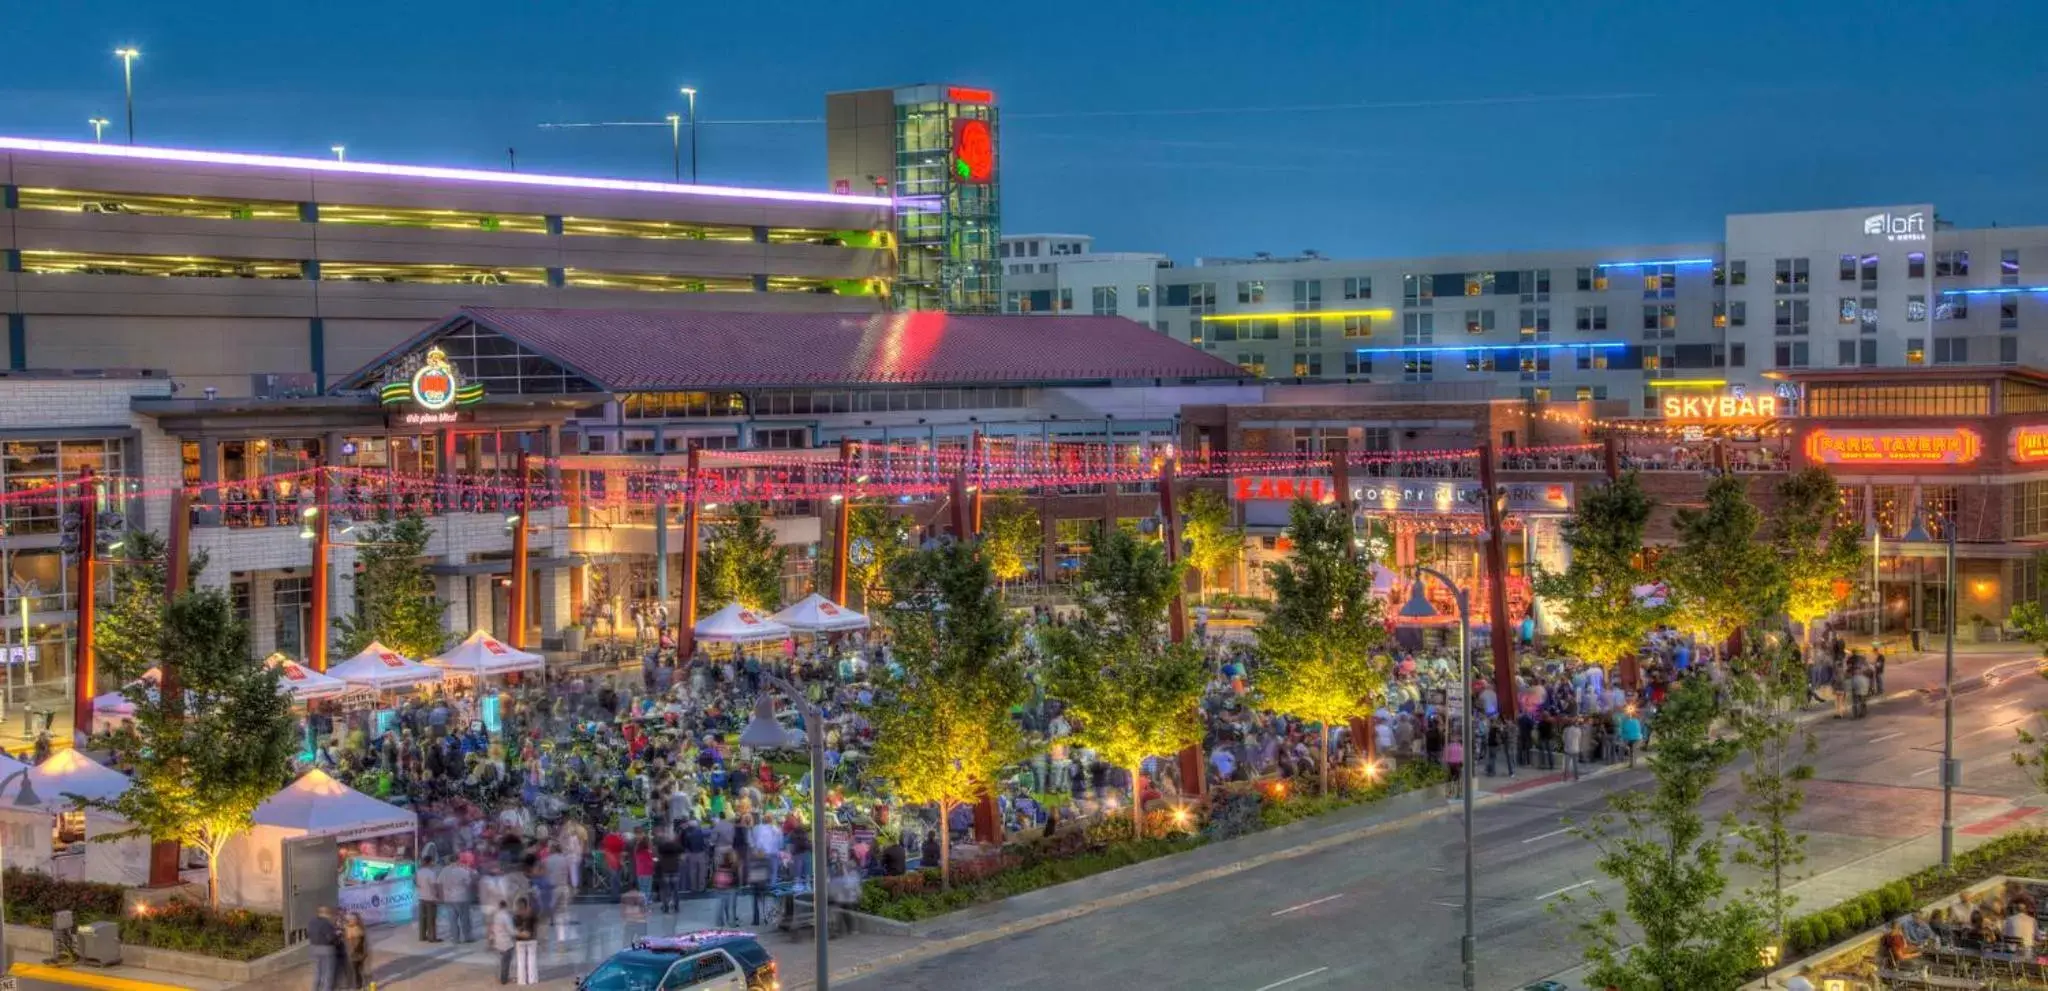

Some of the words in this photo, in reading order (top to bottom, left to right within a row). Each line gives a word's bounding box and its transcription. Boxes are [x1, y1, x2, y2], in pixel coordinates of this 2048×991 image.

[1664, 396, 1776, 417] SKYBAR
[1822, 436, 1876, 451] PARK
[1880, 436, 1961, 451] TAVERN
